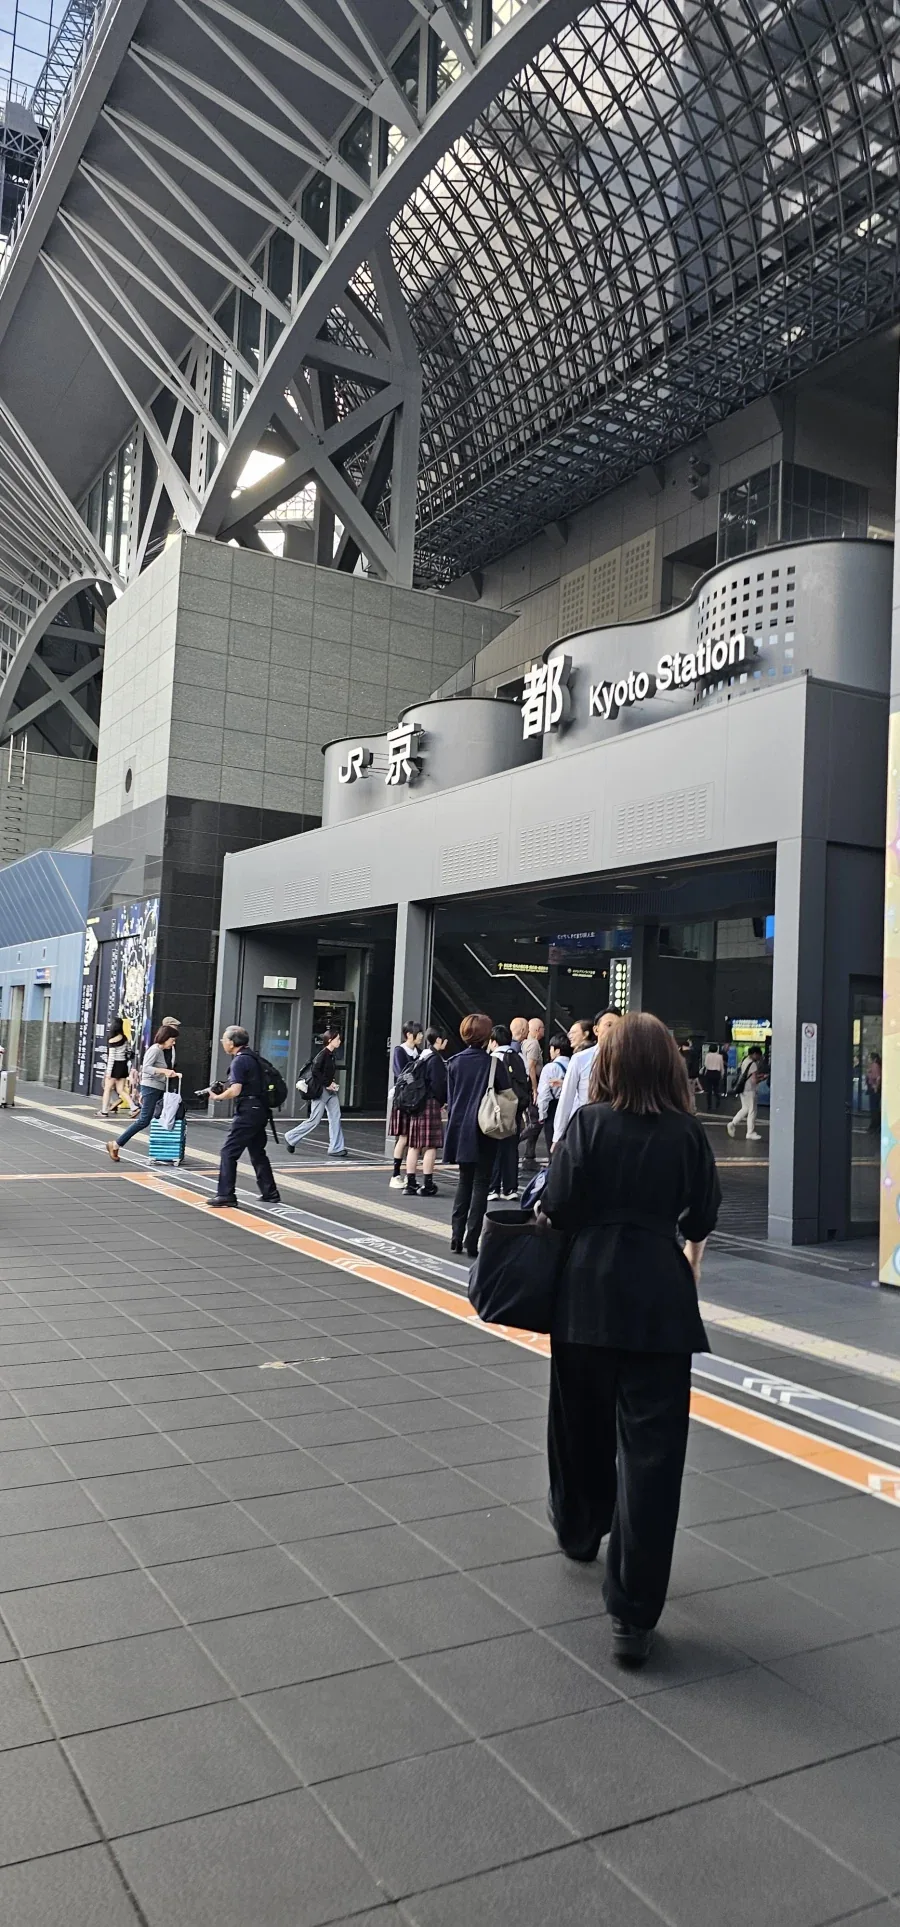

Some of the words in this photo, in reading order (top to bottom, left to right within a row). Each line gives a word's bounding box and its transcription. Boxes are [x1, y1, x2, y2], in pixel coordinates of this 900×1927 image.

[338, 746, 364, 784] JR
[589, 670, 649, 720] Kyoto
[656, 633, 746, 690] Station
